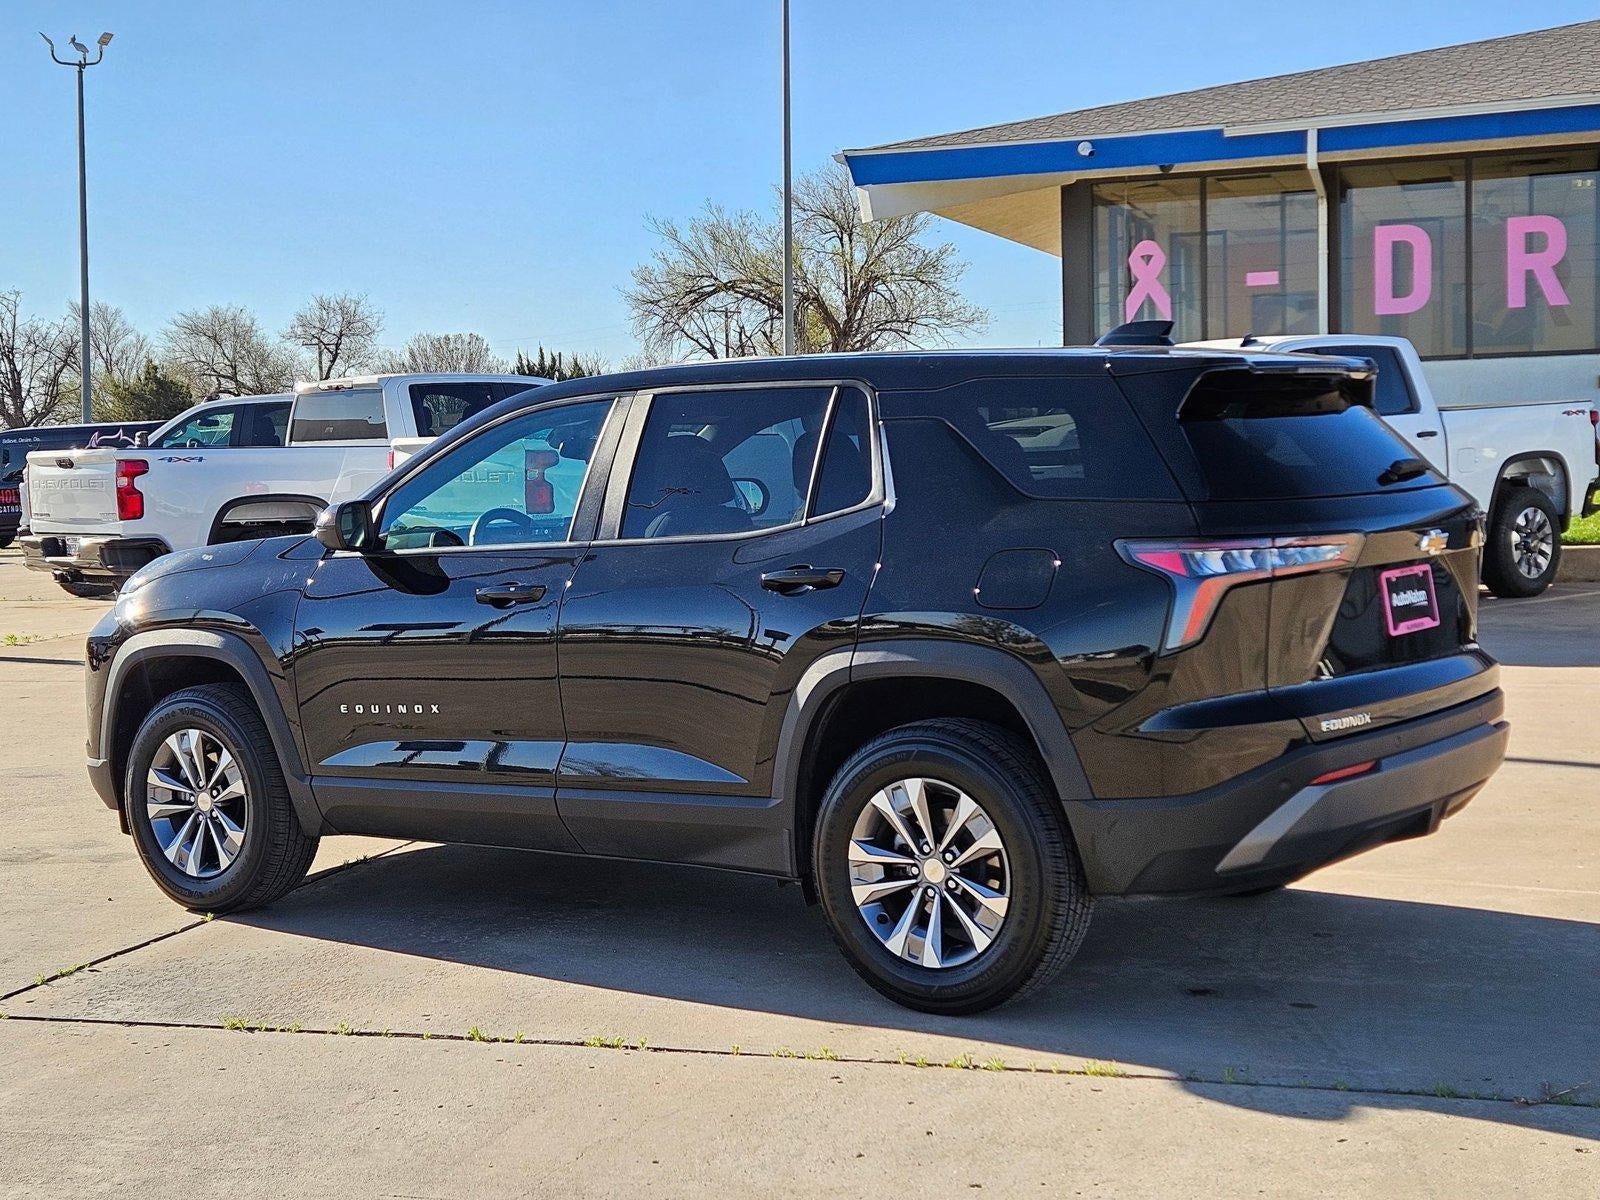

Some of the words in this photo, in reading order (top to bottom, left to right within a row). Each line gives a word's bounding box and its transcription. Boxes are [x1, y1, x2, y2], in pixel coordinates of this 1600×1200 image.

[31, 479, 109, 490] CHEVROLET
[340, 704, 440, 714] EQUINOX
[1321, 712, 1371, 731] EQUINOX
